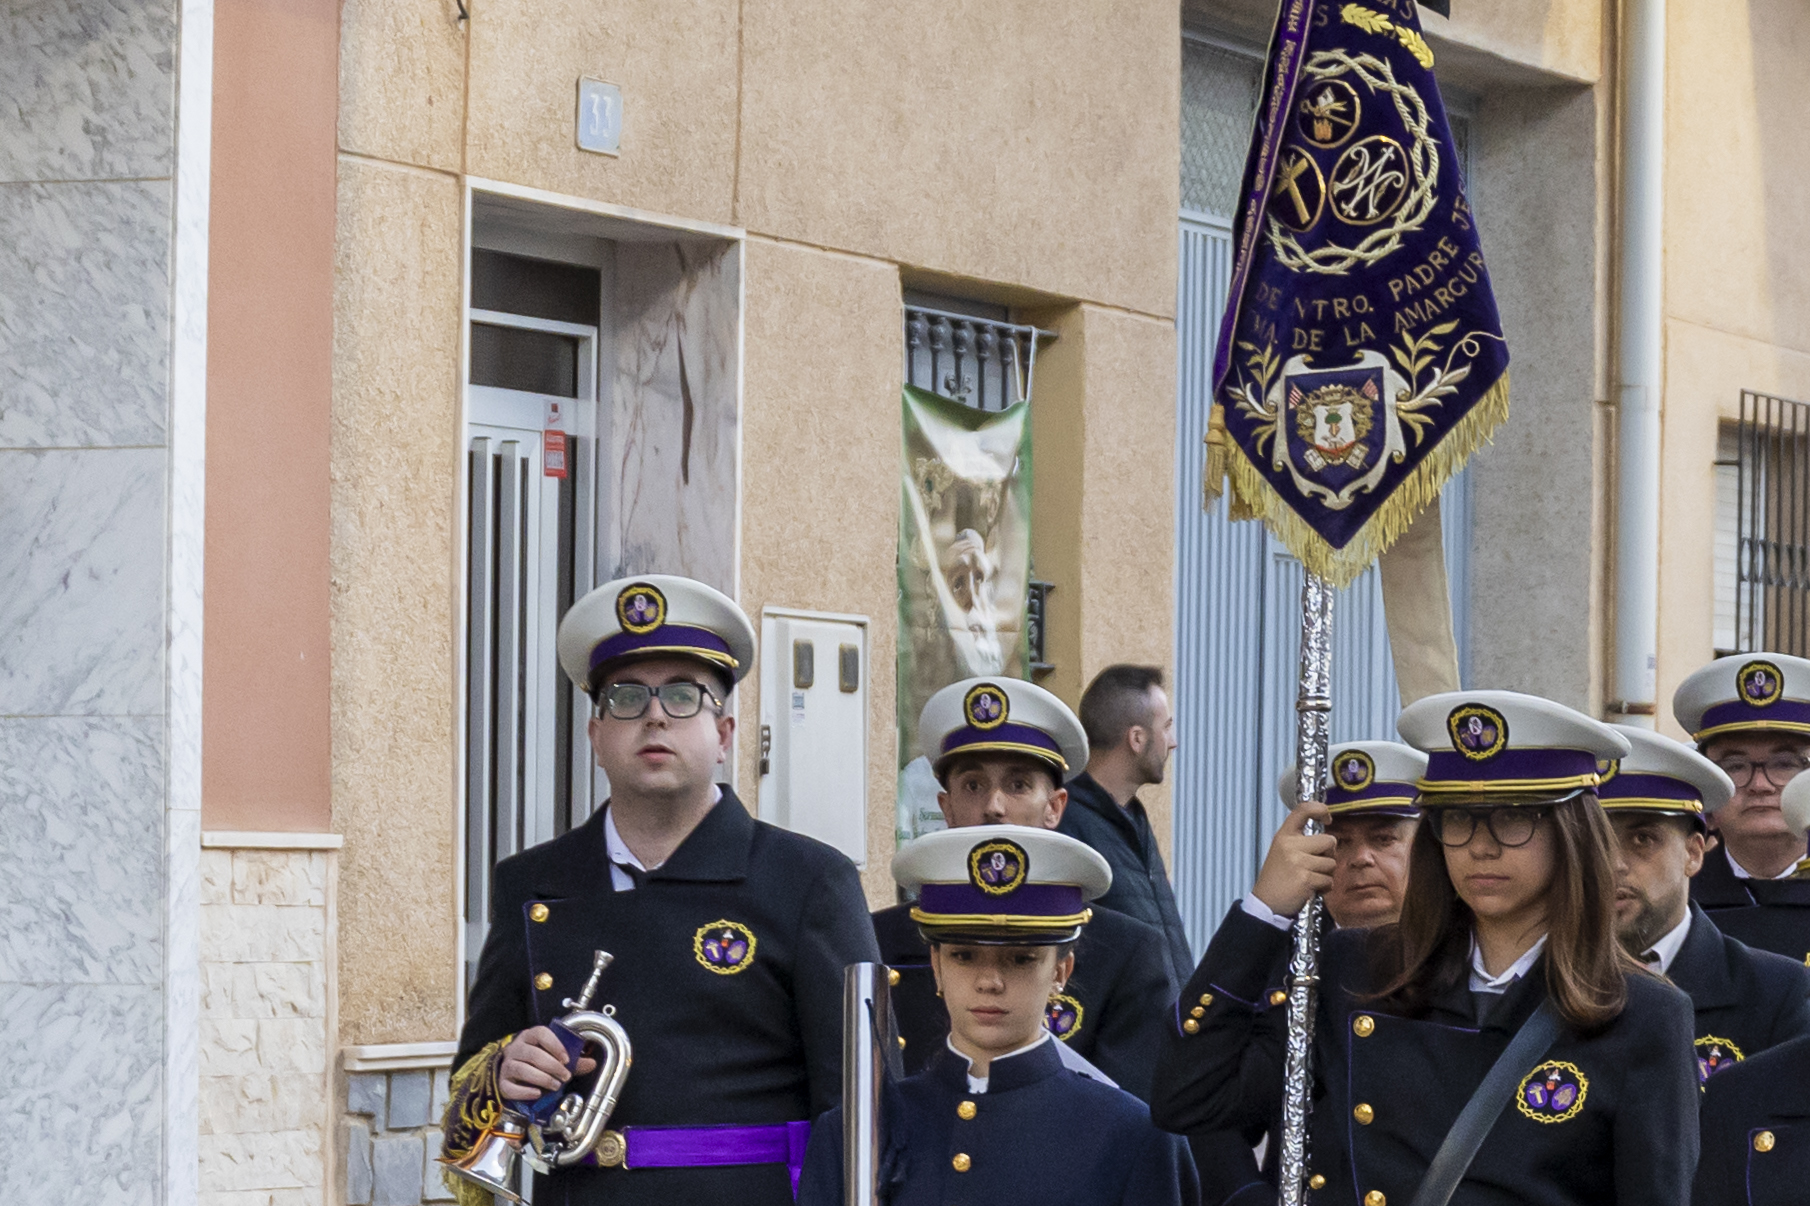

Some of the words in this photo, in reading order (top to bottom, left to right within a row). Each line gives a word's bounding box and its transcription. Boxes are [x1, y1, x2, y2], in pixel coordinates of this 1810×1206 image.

[589, 93, 612, 138] 33
[1387, 235, 1459, 302] PADRE
[1291, 327, 1325, 351] DE
[1343, 321, 1376, 347] LA
